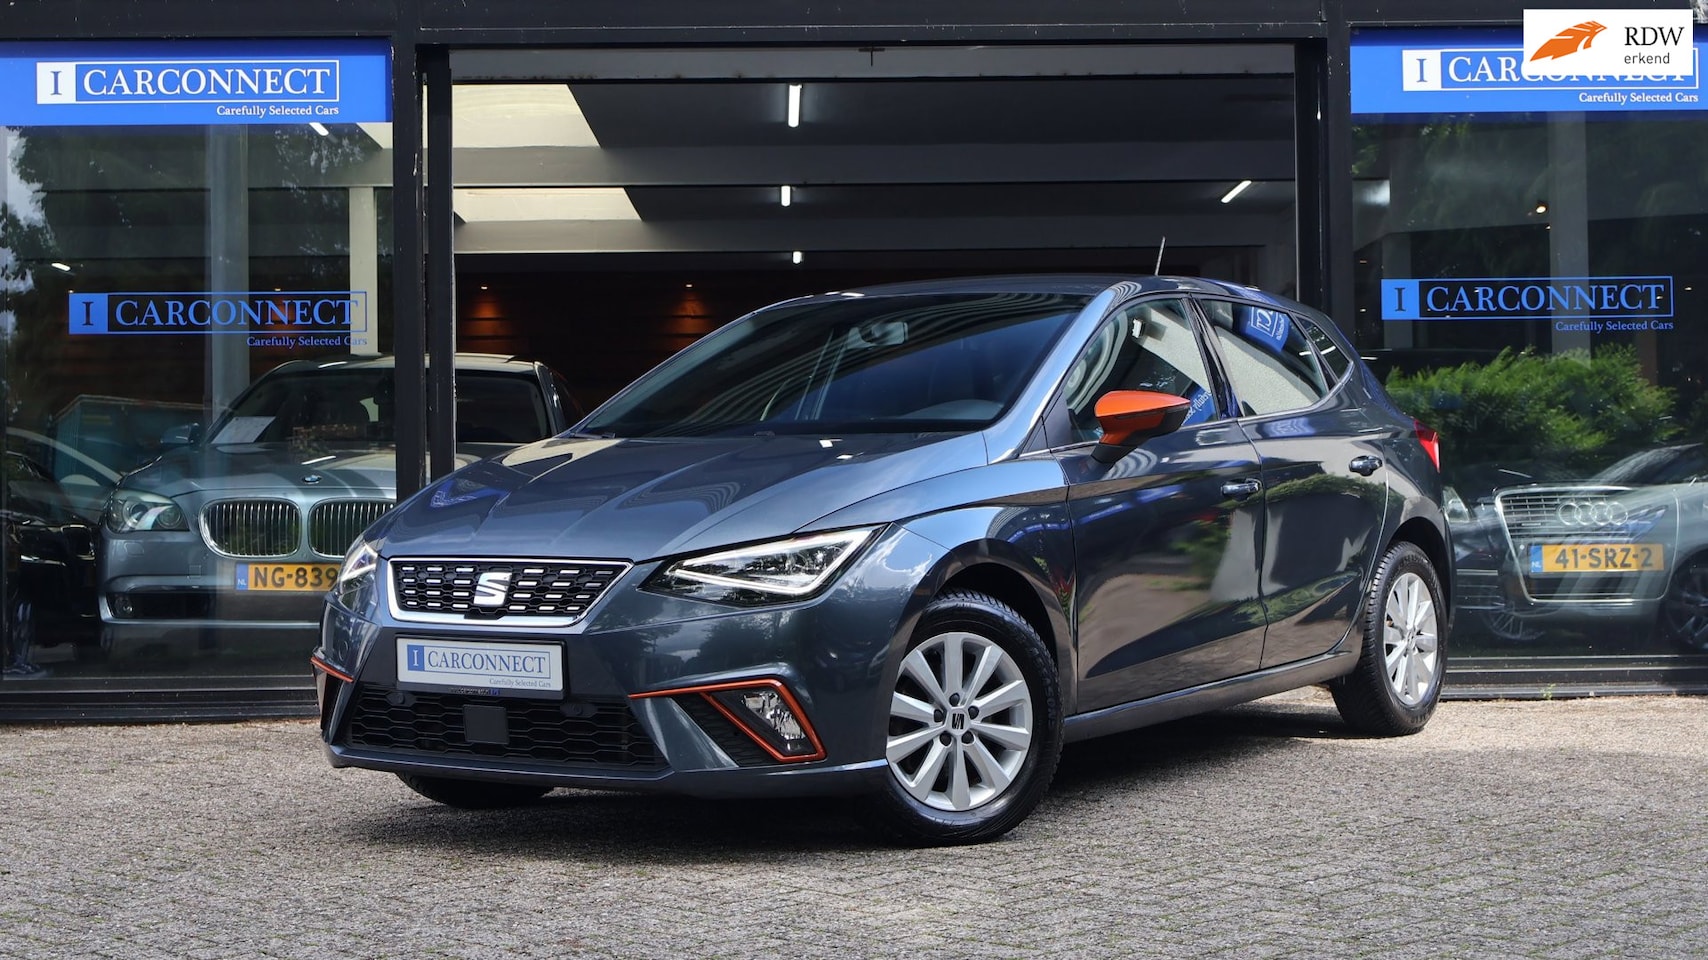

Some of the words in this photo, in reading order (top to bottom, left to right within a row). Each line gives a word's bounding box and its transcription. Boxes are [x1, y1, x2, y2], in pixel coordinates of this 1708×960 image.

[1416, 58, 1427, 83] I
[50, 70, 62, 96] I
[83, 67, 331, 96] CARCONNECT
[1578, 92, 1628, 105] Carefully
[1629, 92, 1673, 103] Selected
[1675, 92, 1699, 103] Cars
[216, 105, 267, 119] Carefully
[269, 105, 312, 116] Selected
[315, 105, 340, 116] Cars
[1394, 287, 1406, 312] I
[1426, 284, 1665, 313] CARCONNECT
[81, 301, 94, 326] I
[115, 298, 359, 327] CARCONNECT
[1555, 321, 1603, 335] Carefully
[1605, 320, 1648, 331] Selected
[1650, 320, 1674, 331] Cars
[246, 336, 296, 350] Carefully
[298, 335, 341, 347] Selected
[345, 335, 368, 347] Cars
[1531, 561, 1542, 569] NL
[1555, 547, 1654, 569] 41-SRZ-2
[237, 578, 247, 586] NL
[412, 649, 419, 667] I
[428, 650, 546, 674] CARCONNECT
[515, 679, 537, 688] Selected
[539, 680, 551, 688] Cars
